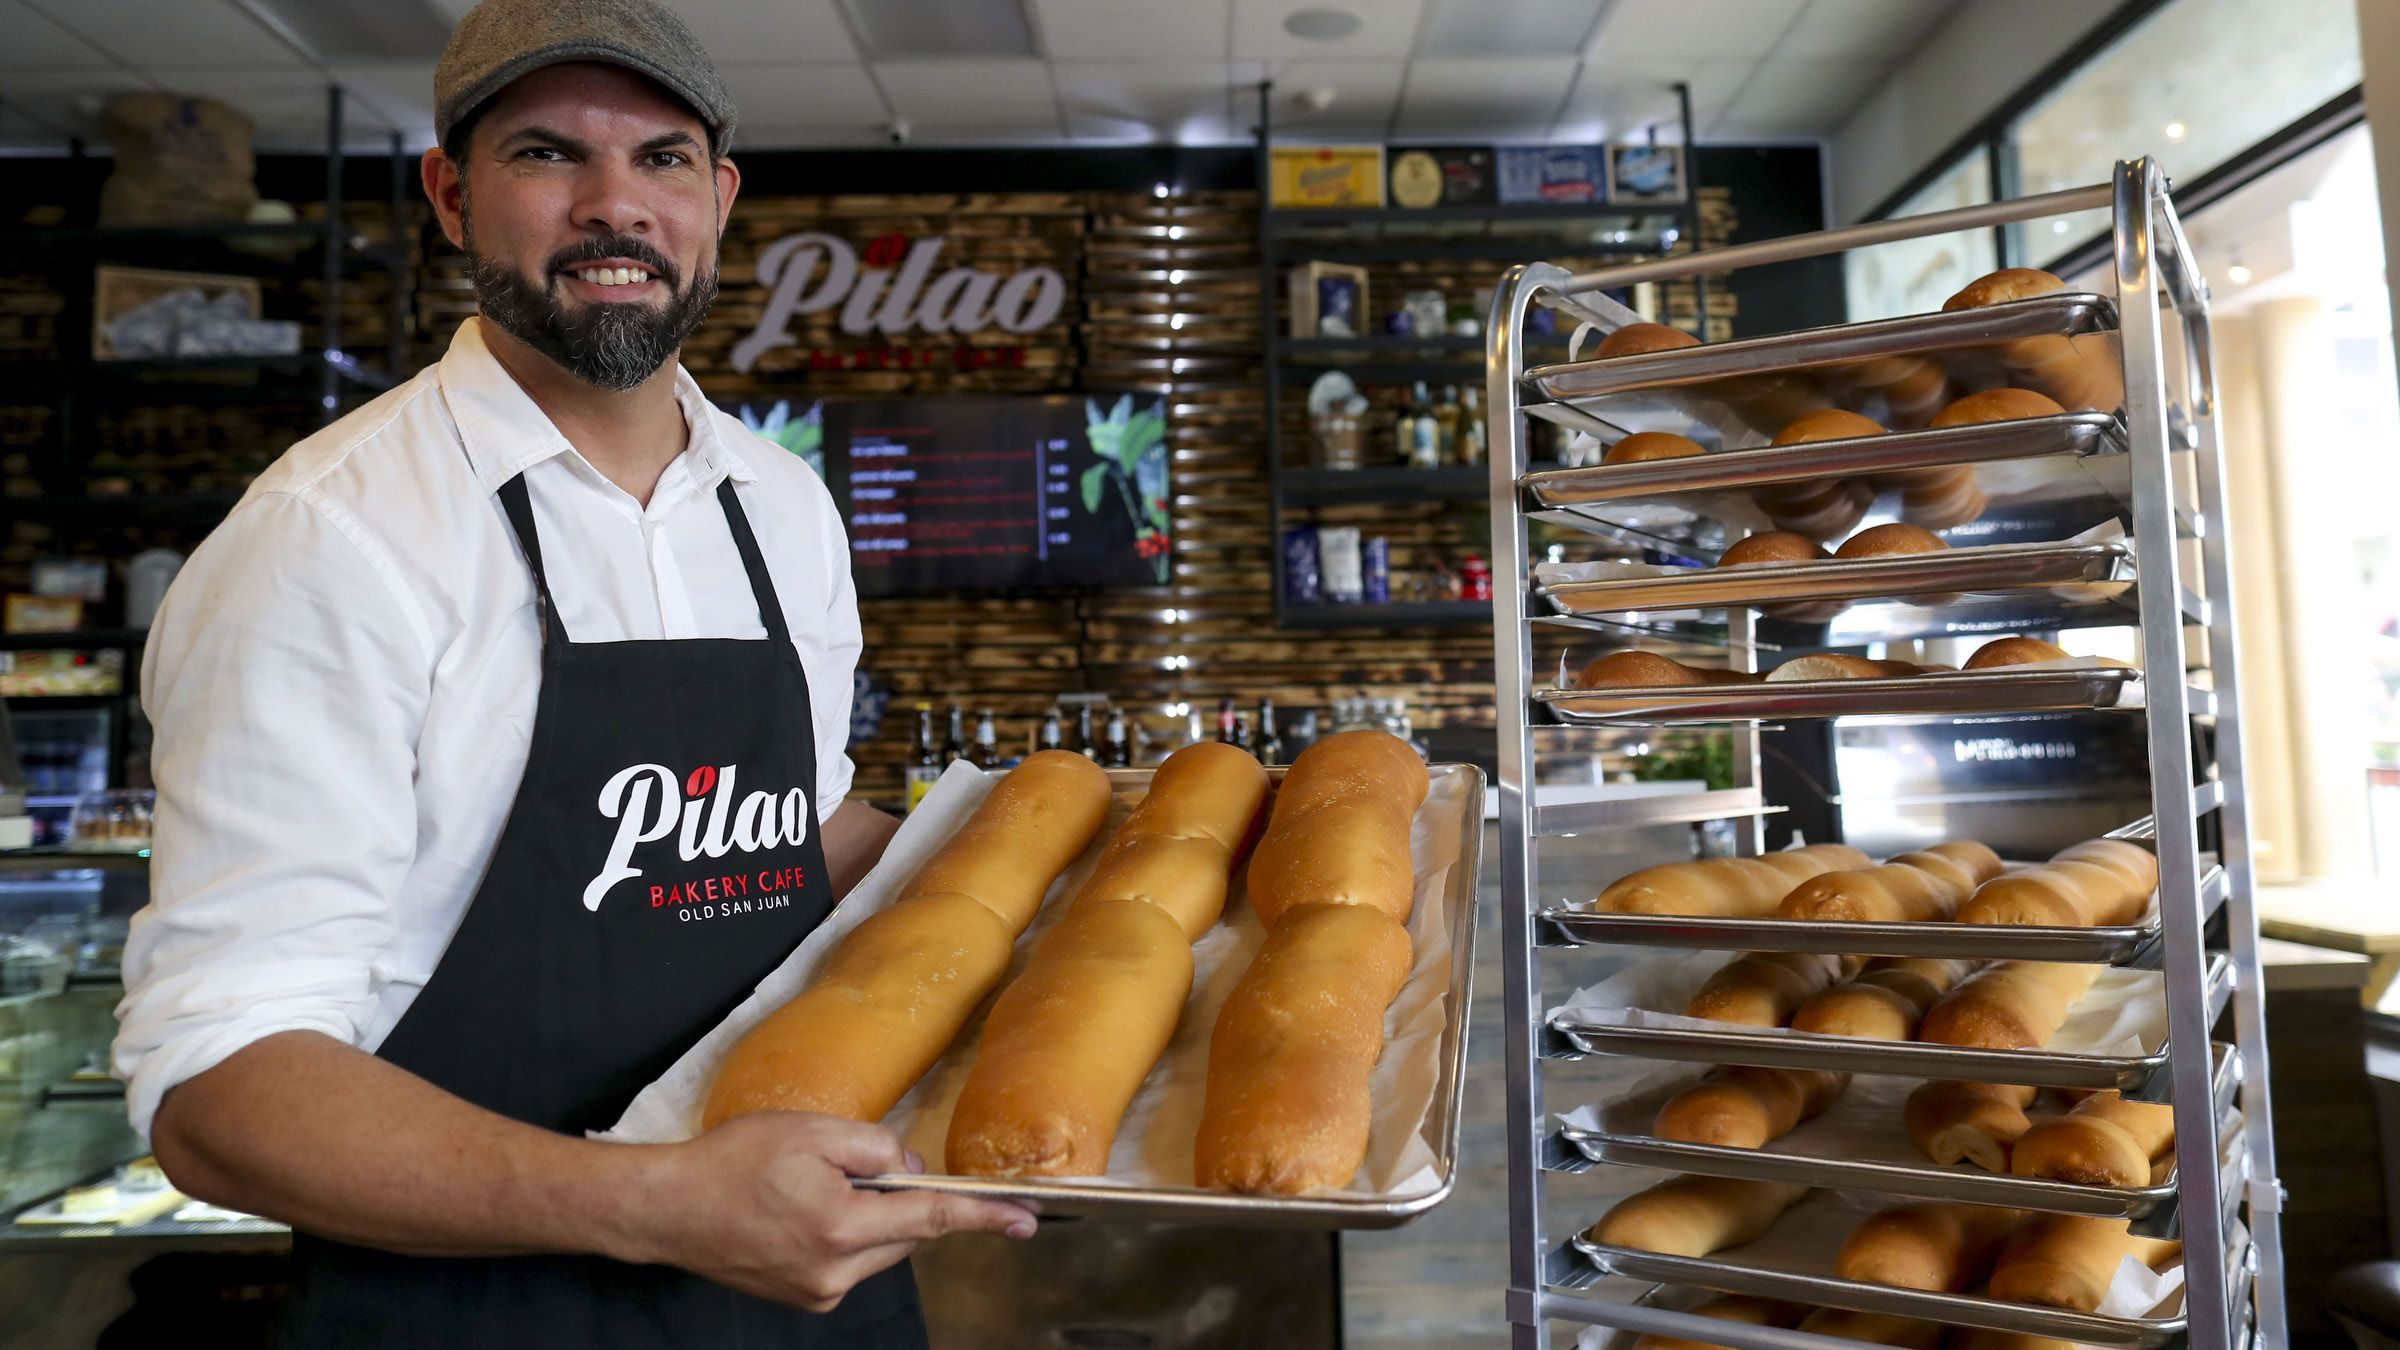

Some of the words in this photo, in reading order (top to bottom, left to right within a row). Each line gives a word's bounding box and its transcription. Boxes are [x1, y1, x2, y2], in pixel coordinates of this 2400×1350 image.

[731, 232, 1066, 374] Pilao
[583, 763, 808, 912] Pilao
[650, 874, 748, 907] BAKERY
[758, 867, 804, 892] CAFE
[679, 905, 714, 922] OLD
[721, 900, 751, 916] SAN
[757, 895, 789, 911] JUAN
